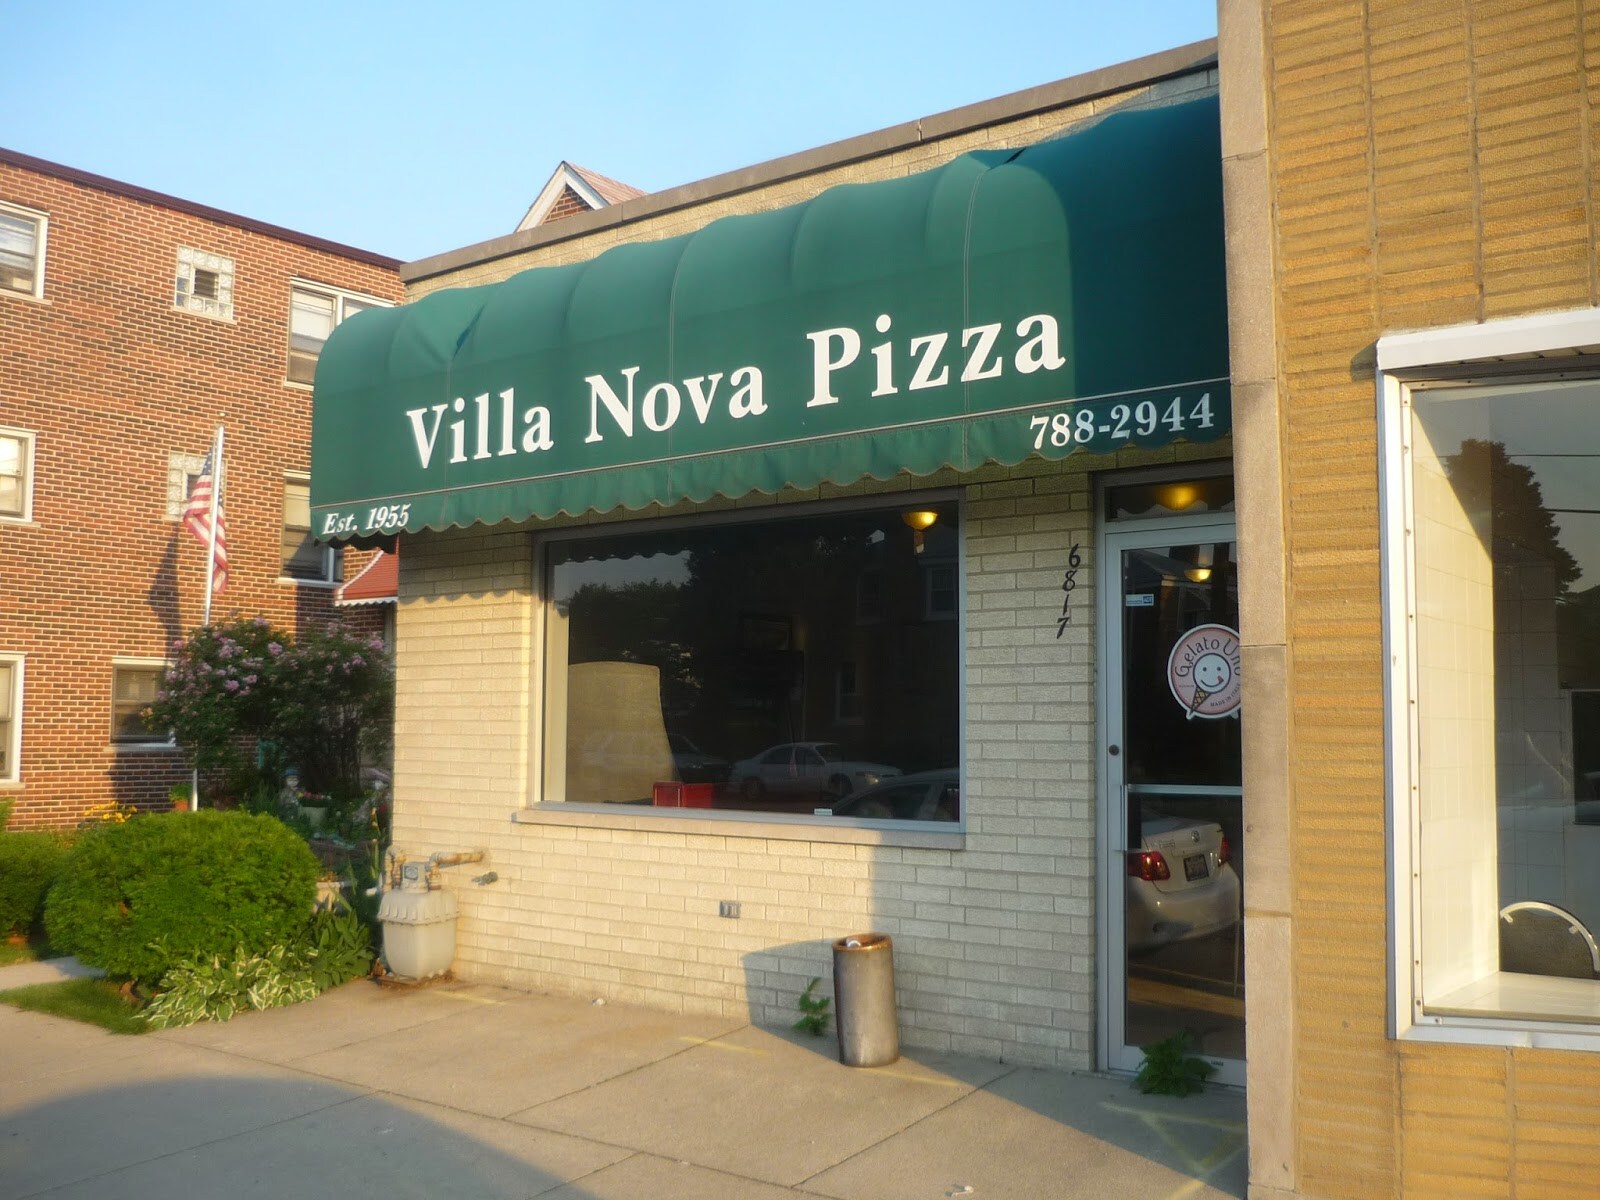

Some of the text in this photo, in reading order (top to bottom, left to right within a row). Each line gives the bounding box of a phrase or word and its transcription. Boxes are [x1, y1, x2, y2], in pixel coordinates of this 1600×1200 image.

[405, 313, 1066, 469] Villa Nova Pizza
[1029, 393, 1214, 450] 788-2944
[322, 503, 412, 535] Est. 1955
[1056, 543, 1081, 640] 6817
[1174, 636, 1220, 677] Gelato
